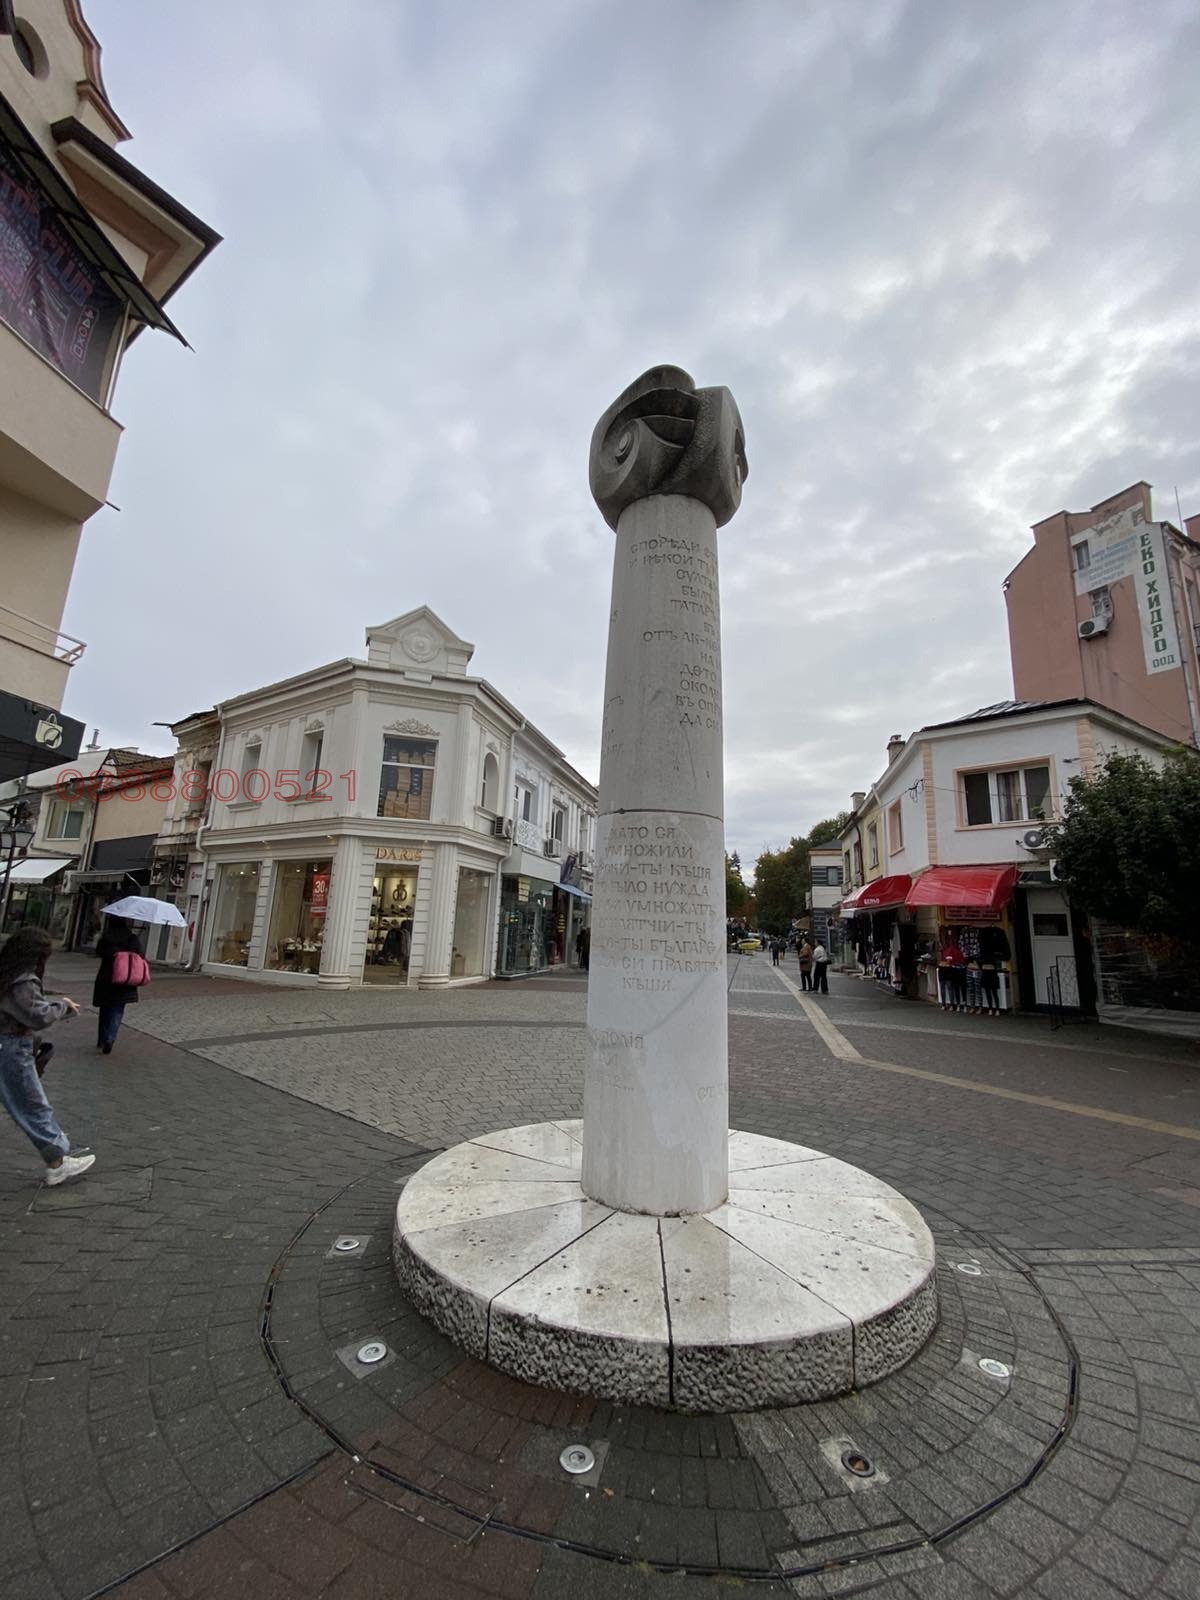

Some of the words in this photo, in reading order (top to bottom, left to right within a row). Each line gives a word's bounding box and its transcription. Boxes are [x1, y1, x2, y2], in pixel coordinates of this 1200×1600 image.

[1140, 533, 1155, 575] ЕКО
[1146, 580, 1168, 653] ХИДРО
[655, 826, 676, 840] СЯ
[603, 843, 693, 859] УМНОЖИЛИ
[653, 880, 709, 898] НУЖДА
[626, 898, 716, 916] УМНОЖАТЪ
